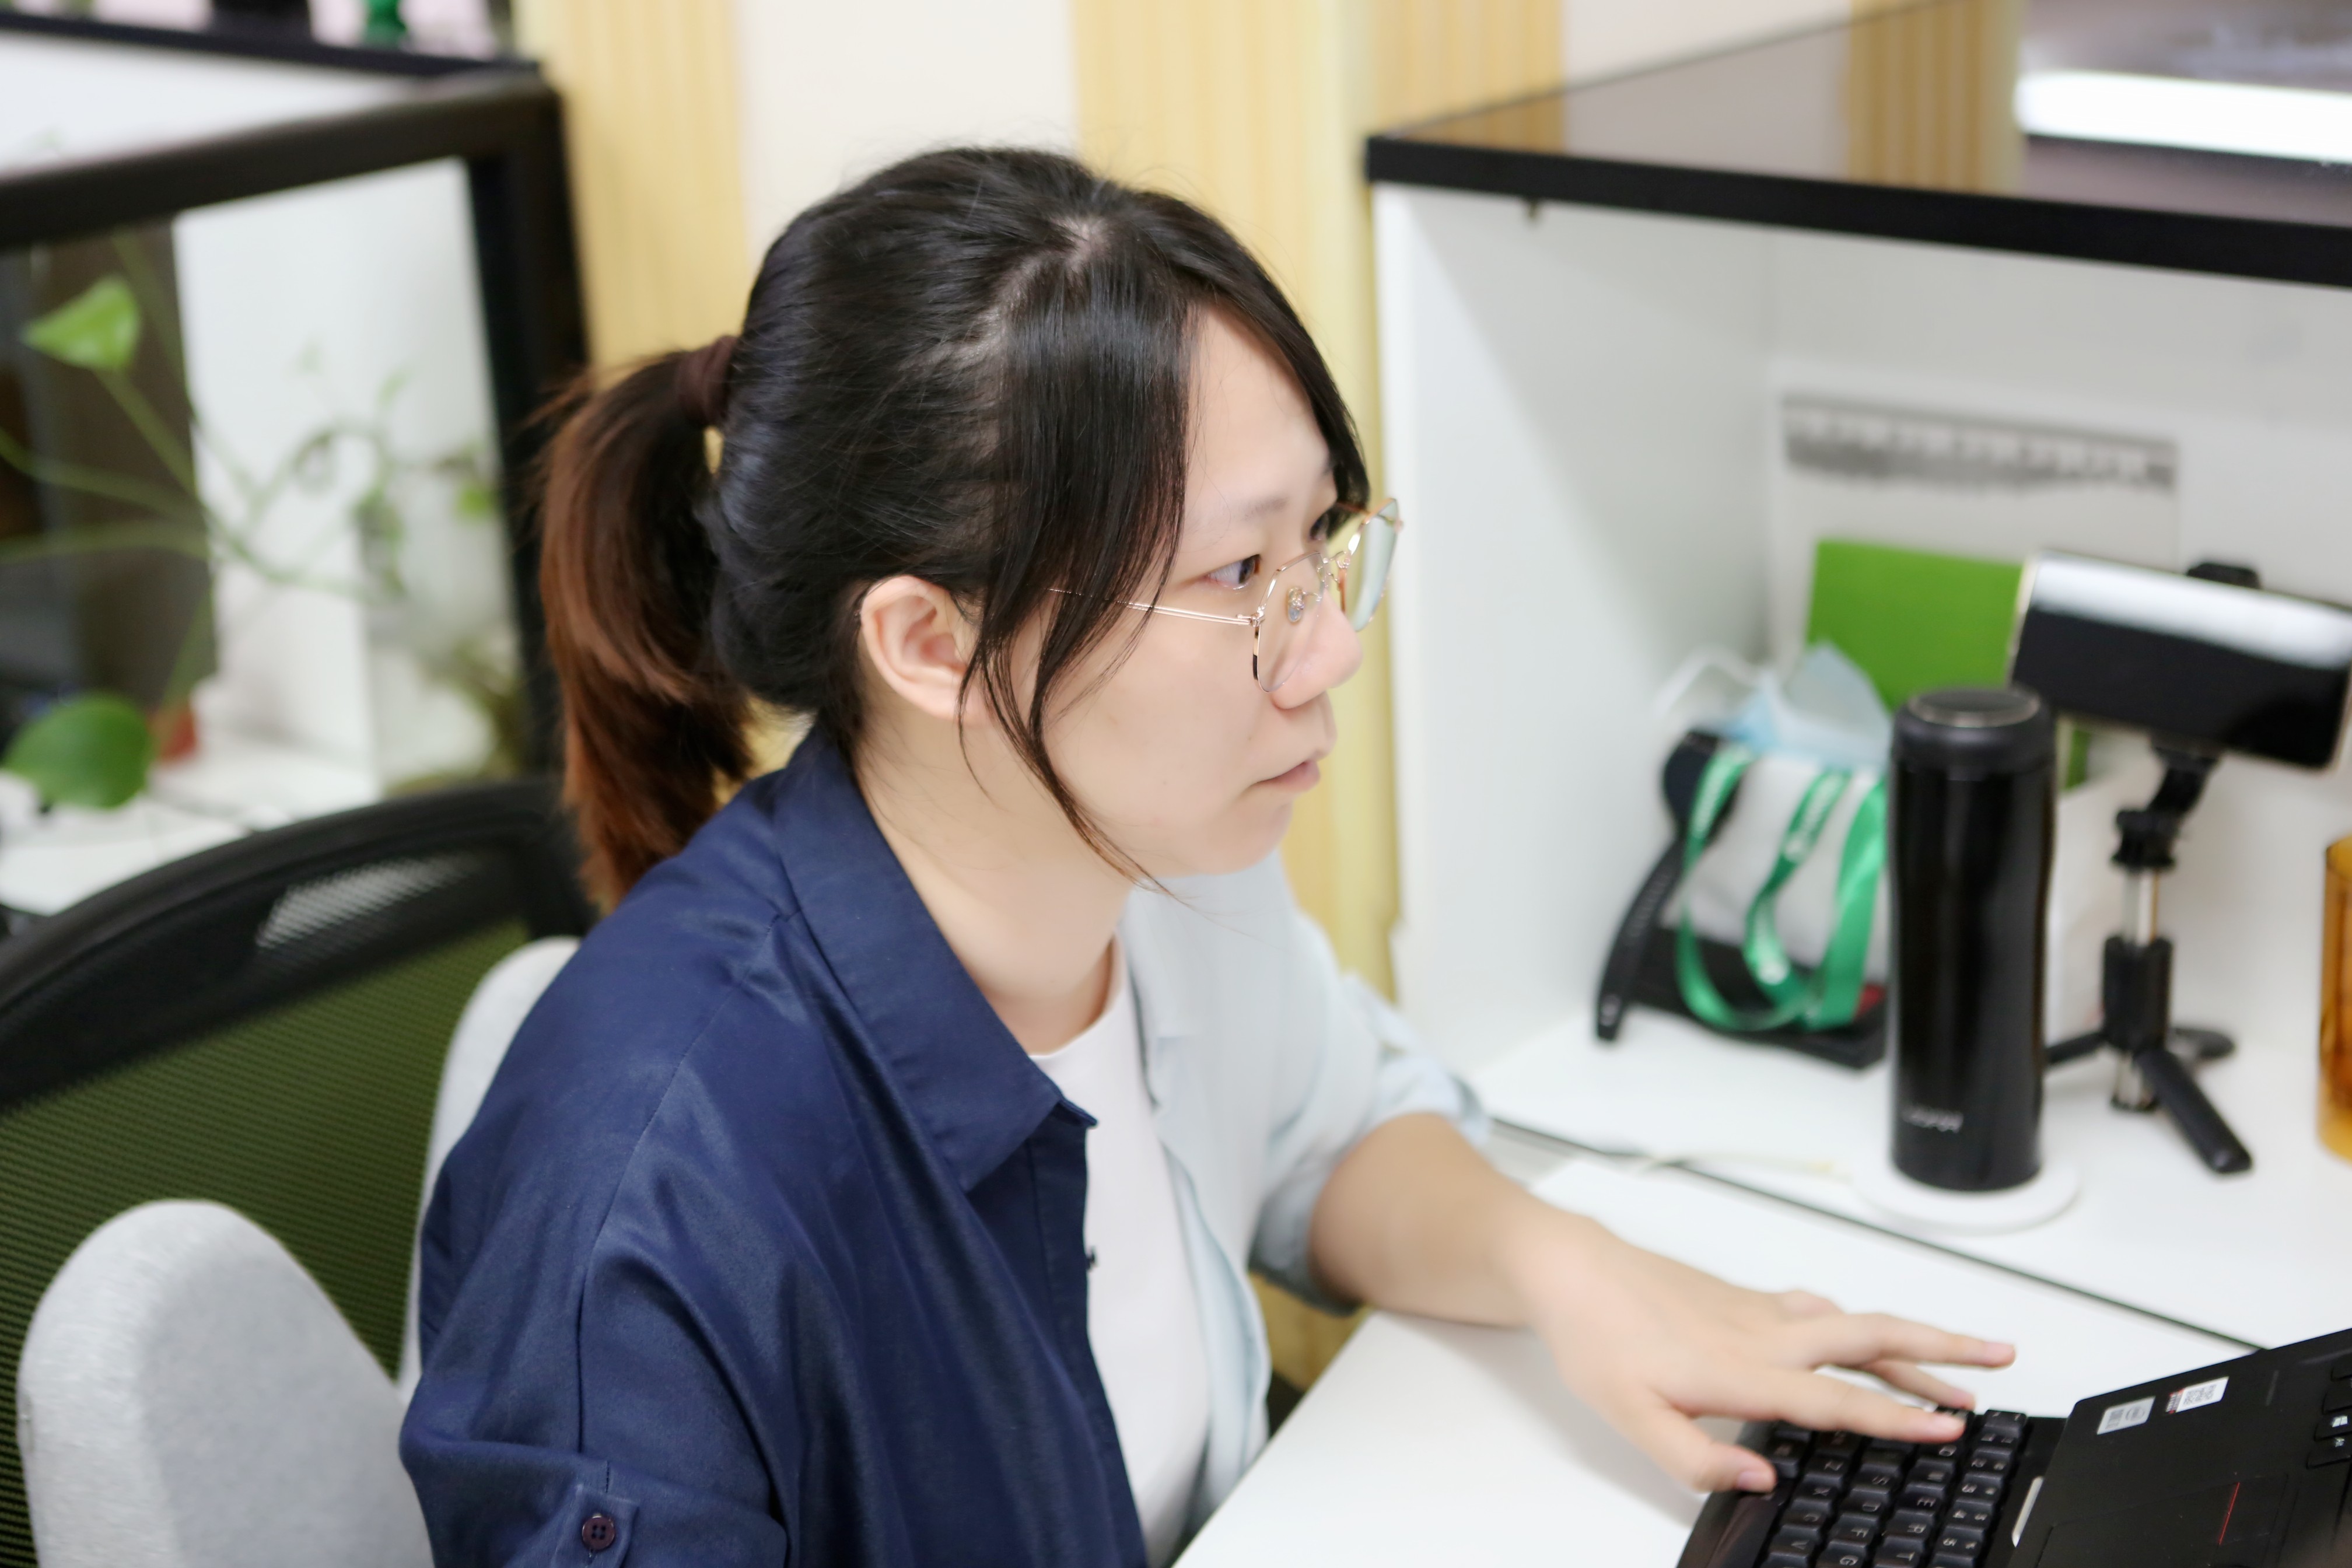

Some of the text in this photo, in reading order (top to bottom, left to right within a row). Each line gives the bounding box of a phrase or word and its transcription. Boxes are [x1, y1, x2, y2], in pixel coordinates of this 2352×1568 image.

[1872, 1475, 1890, 1485] S
[1917, 1496, 1937, 1507] E
[1863, 1502, 1881, 1512] D
[1851, 1527, 1870, 1538] F
[1908, 1523, 1927, 1534] R
[1791, 1540, 1809, 1549] V
[1840, 1555, 1859, 1566] G
[1896, 1552, 1916, 1562] T
